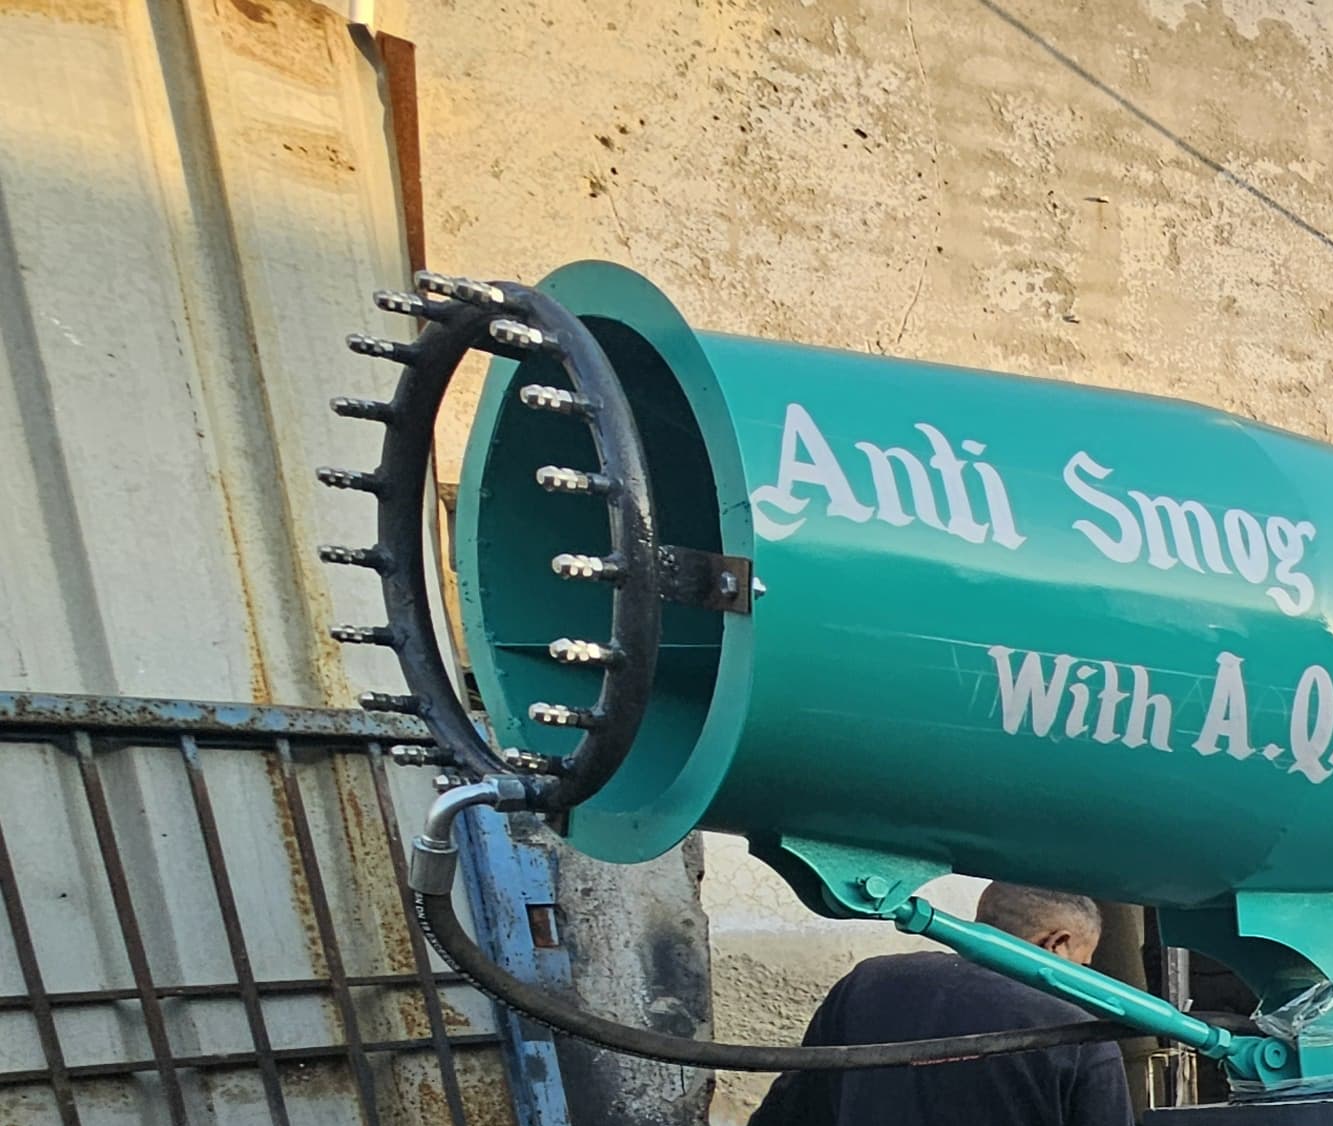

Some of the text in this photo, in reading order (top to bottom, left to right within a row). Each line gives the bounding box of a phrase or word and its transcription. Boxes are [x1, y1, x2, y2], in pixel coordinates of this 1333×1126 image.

[749, 402, 1028, 552] Anti
[1064, 450, 1316, 616] Smog
[988, 645, 1173, 753] With
